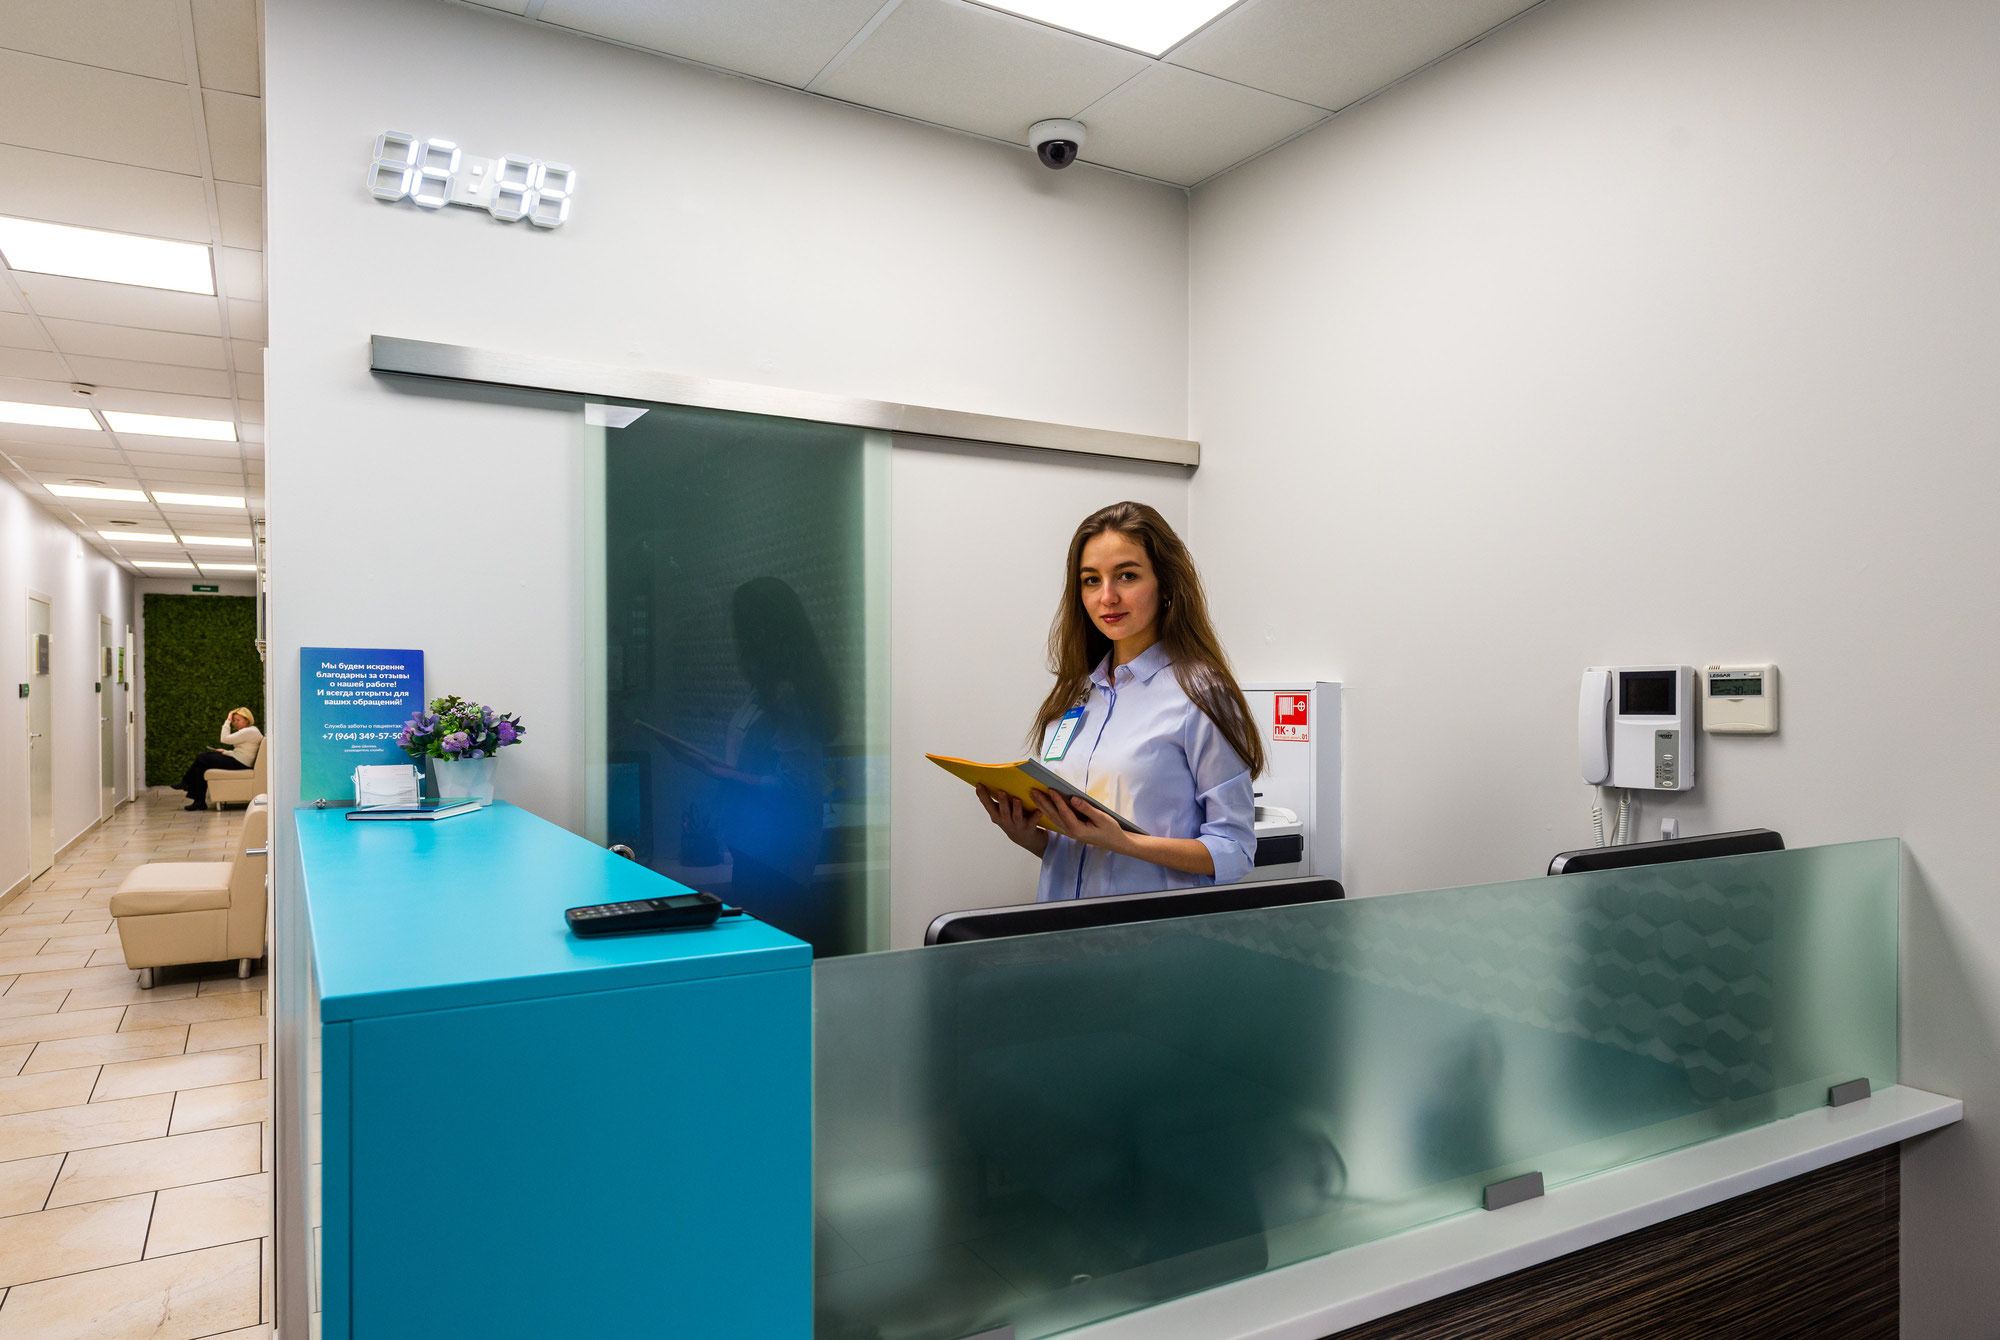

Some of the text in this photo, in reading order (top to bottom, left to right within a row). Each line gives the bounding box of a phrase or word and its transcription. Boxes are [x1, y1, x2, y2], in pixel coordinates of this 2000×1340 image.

[338, 662, 365, 670] будем
[316, 671, 367, 679] благодарны
[337, 680, 364, 688] нашей
[366, 681, 397, 689] работе!
[335, 732, 358, 741] (964)
